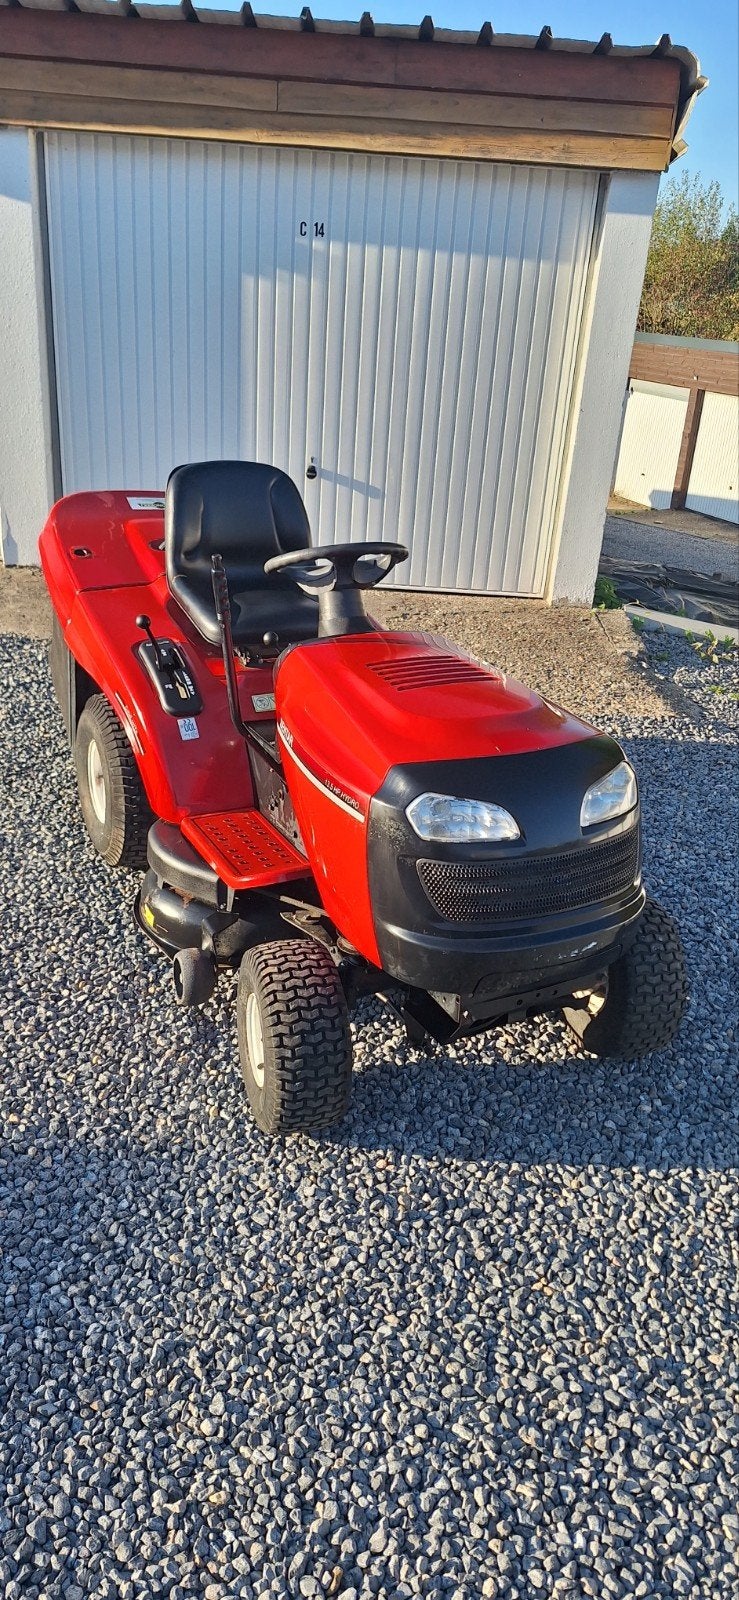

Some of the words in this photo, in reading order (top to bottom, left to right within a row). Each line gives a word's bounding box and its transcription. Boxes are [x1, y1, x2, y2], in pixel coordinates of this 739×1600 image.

[300, 221, 307, 237] C
[314, 221, 325, 238] 14
[340, 790, 360, 810] HYDRO
